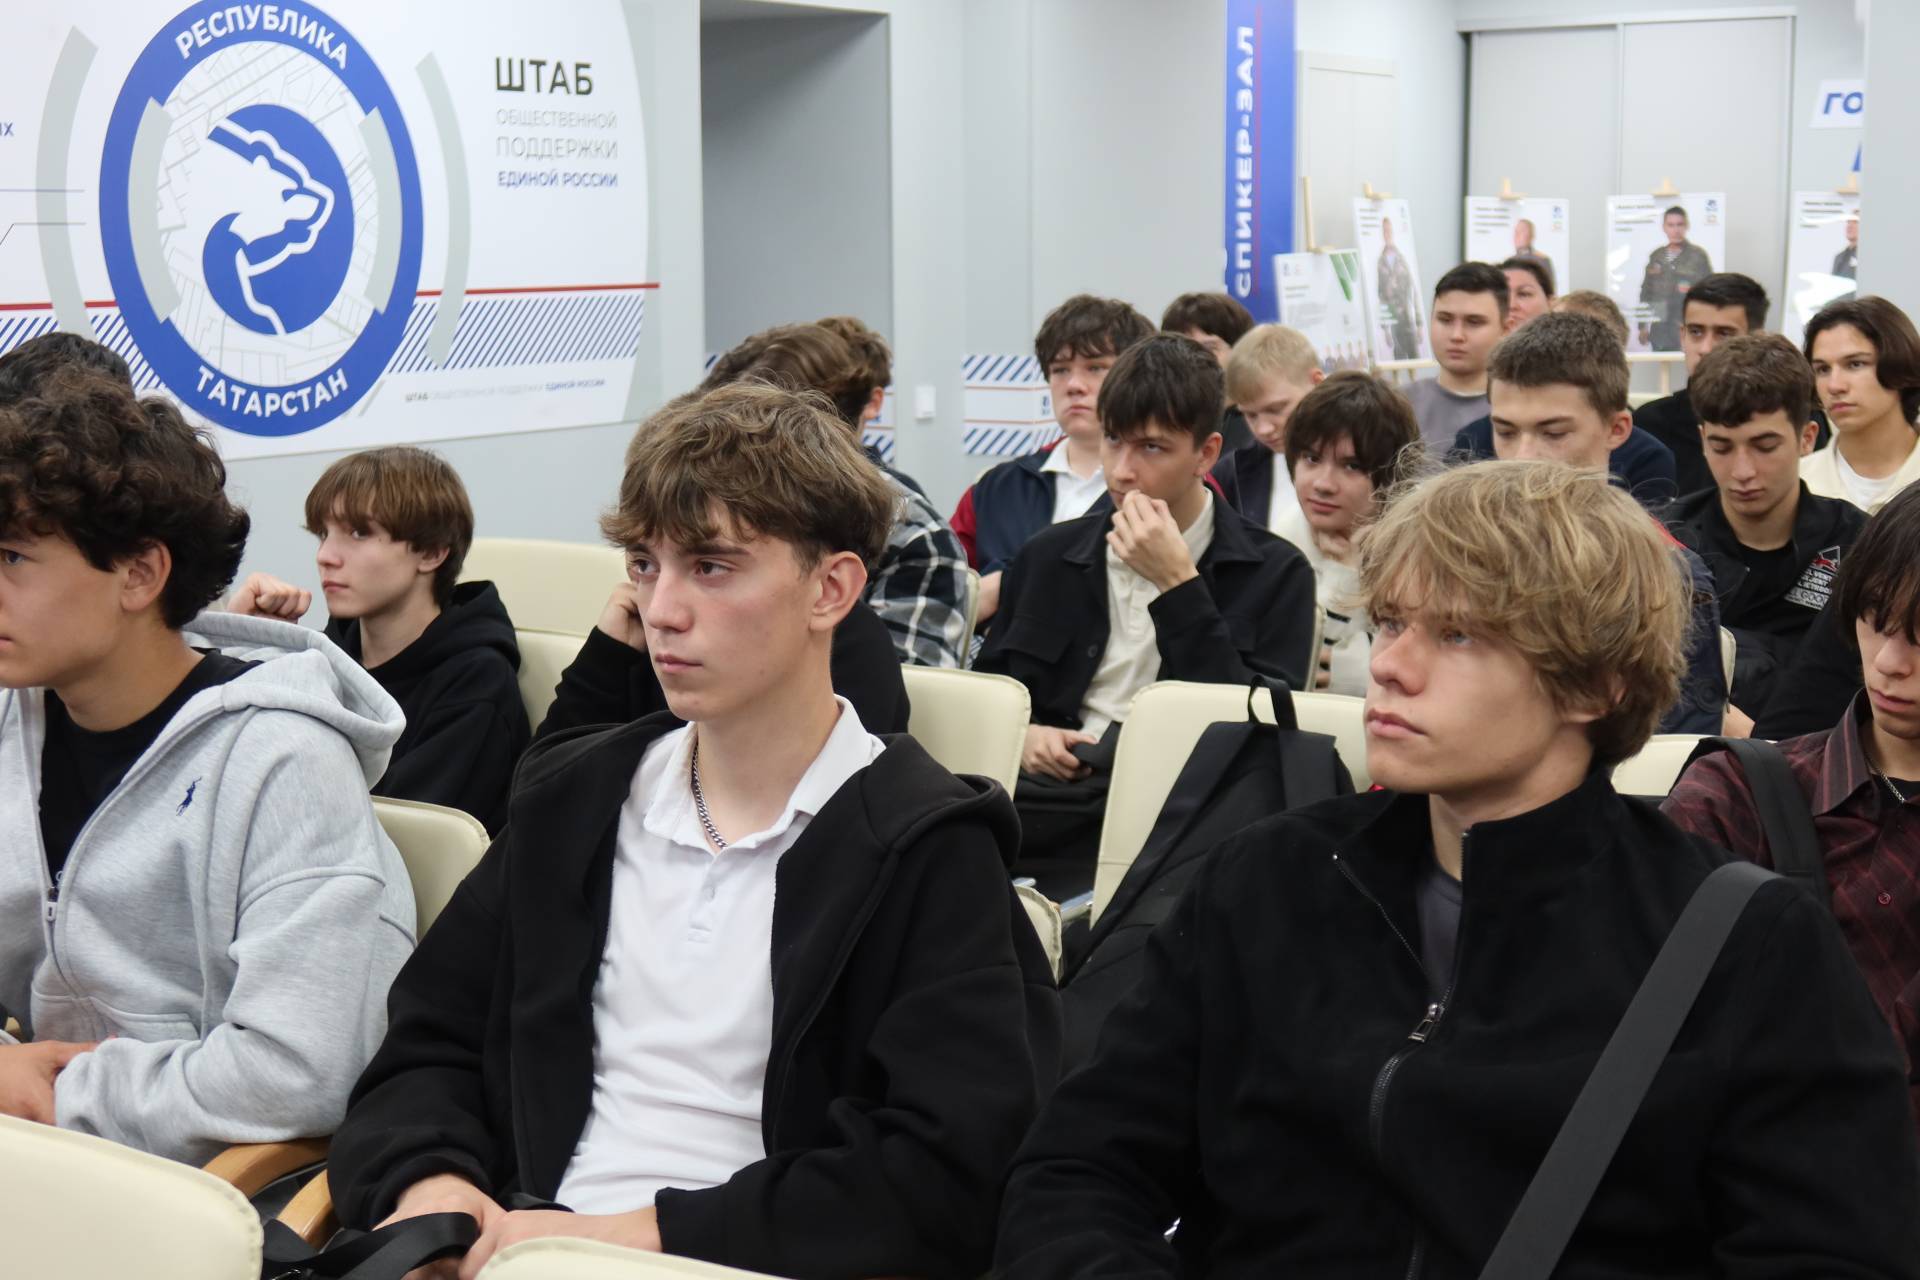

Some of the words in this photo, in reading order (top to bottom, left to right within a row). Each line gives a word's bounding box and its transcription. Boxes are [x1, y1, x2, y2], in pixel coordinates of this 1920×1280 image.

[174, 4, 348, 70] РЕСПУБЛИКА
[496, 57, 593, 95] ШТАБ
[496, 108, 617, 128] ОБЩЕСТВЕННОЙ
[496, 136, 618, 160] ПОДДЕРЖКИ
[1236, 26, 1253, 298] СПИКЕР-ЗАЛ
[498, 169, 559, 187] ЕДИНОЙ
[563, 172, 618, 186] РОССИИ
[197, 366, 348, 417] ТАТАРСТАН
